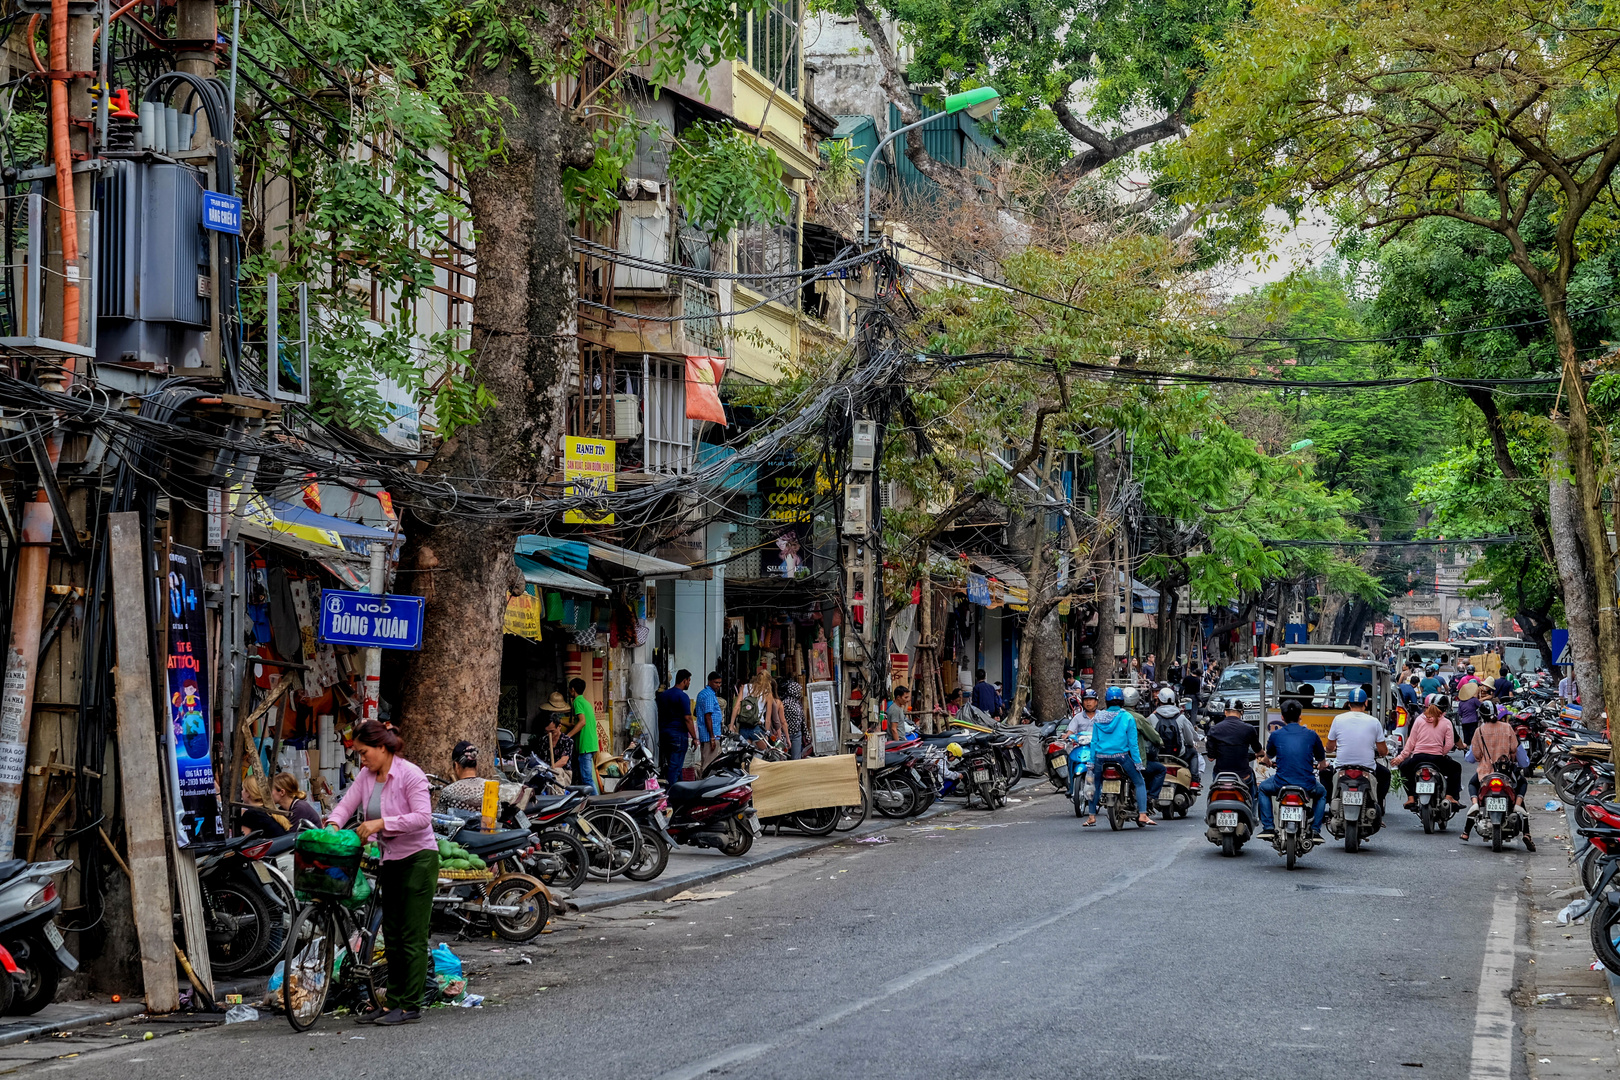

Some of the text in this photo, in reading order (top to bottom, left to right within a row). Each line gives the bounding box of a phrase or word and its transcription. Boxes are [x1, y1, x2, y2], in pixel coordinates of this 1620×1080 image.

[576, 443, 605, 456] HẠNH TÍN
[332, 612, 408, 639] ĐỒNG XUÂN
